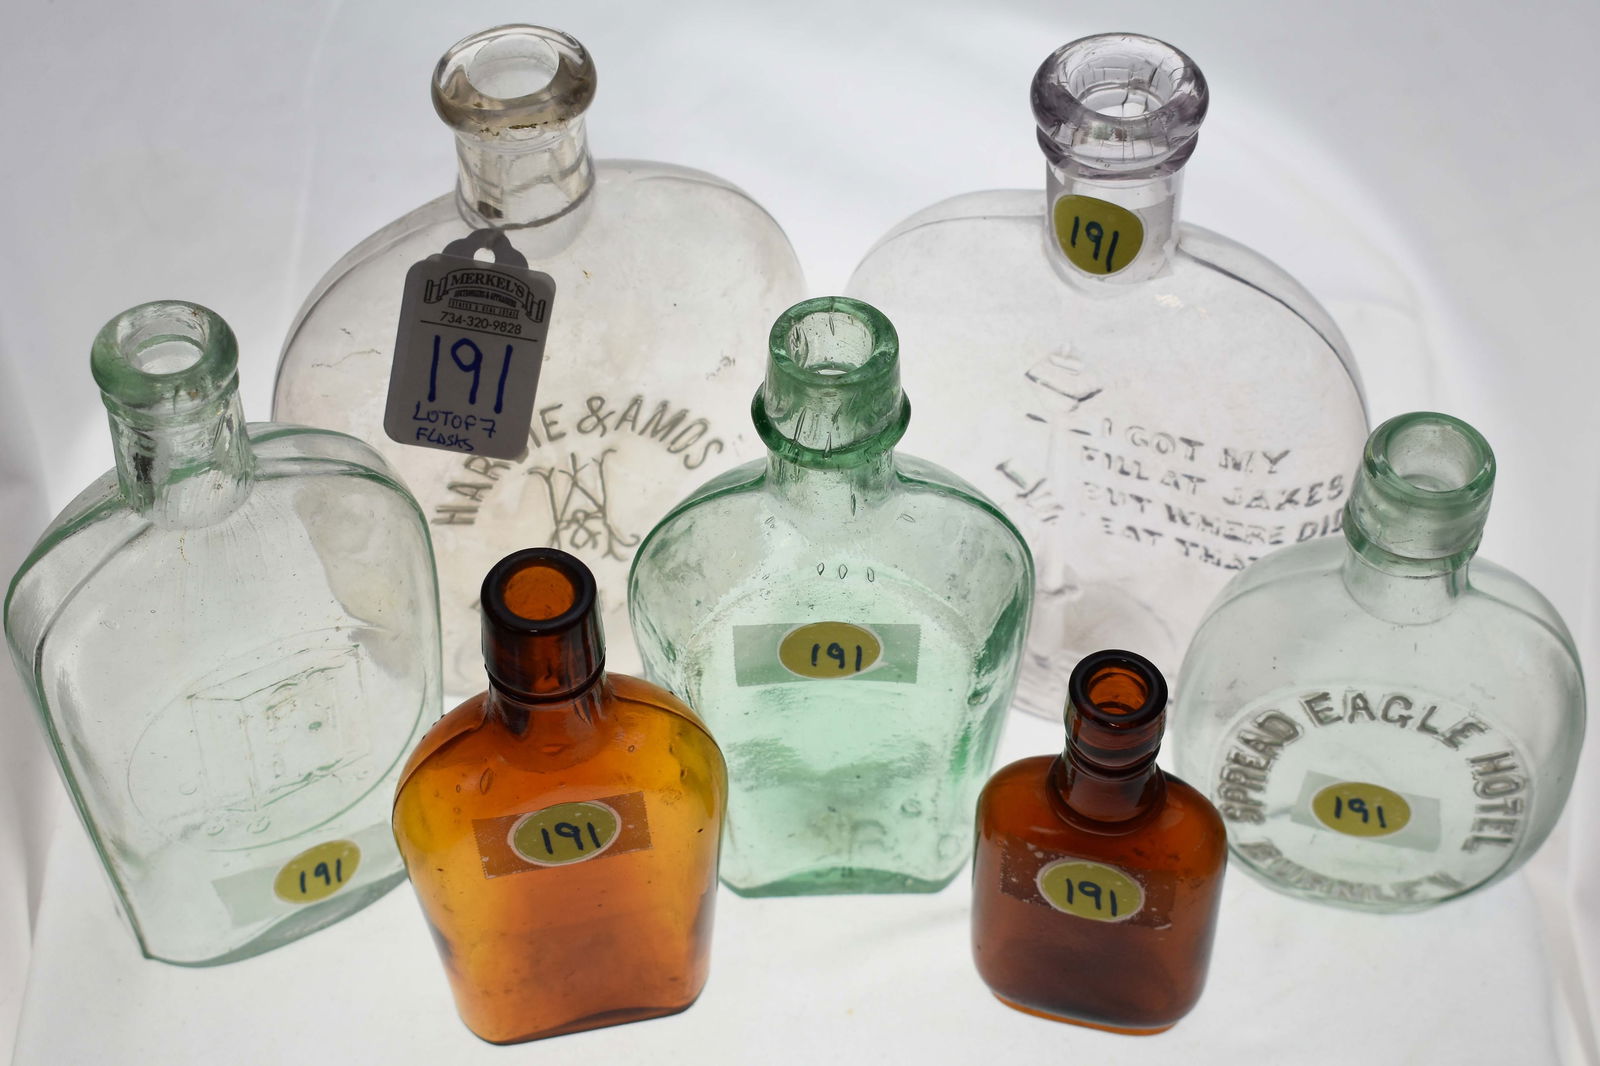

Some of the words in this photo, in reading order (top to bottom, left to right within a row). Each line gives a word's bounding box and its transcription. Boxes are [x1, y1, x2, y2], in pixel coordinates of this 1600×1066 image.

[1071, 216, 1119, 272] 191
[450, 272, 526, 299] MERKEL'S
[439, 311, 522, 336] 734-320-9828
[428, 335, 513, 414] 191
[1126, 424, 1205, 462] GOT
[1160, 468, 1207, 496] AT
[1164, 502, 1285, 545] WHERE
[811, 642, 862, 672] 191
[1218, 711, 1302, 826] SPREAD
[1303, 690, 1490, 751] EAGLE
[1461, 750, 1526, 853] HOTEL
[1335, 796, 1387, 828] 191
[541, 822, 600, 854] 191
[299, 858, 342, 893] 191
[1066, 878, 1118, 917] 191
